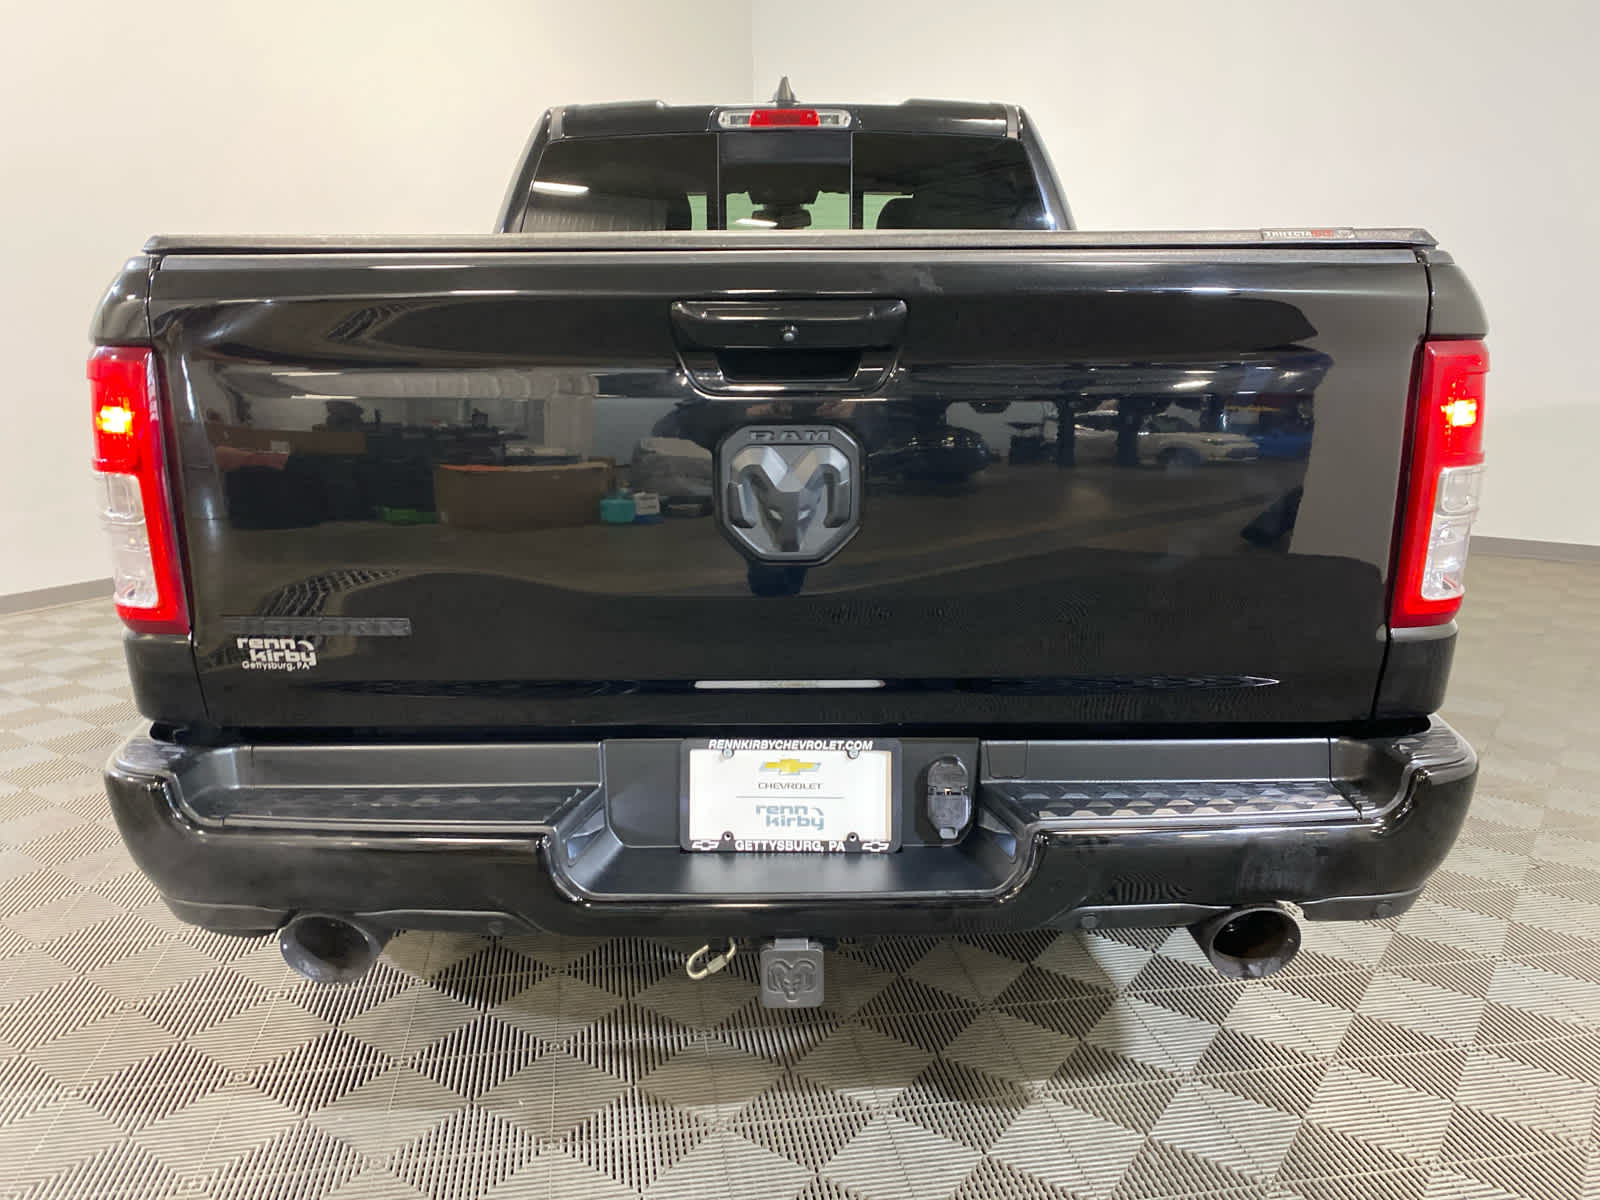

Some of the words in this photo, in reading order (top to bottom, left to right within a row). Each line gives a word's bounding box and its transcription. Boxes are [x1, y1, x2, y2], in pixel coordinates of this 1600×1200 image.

[750, 430, 832, 442] RAM
[236, 637, 296, 650] renn
[250, 650, 317, 667] kirby
[708, 738, 874, 751] RENNKIRBYCHEVROLET.COM
[758, 782, 823, 790] CHEVROLET
[755, 805, 809, 815] renn
[766, 816, 825, 831] kirby
[734, 840, 825, 852] GETTYSBURG,
[829, 841, 846, 851] PA
